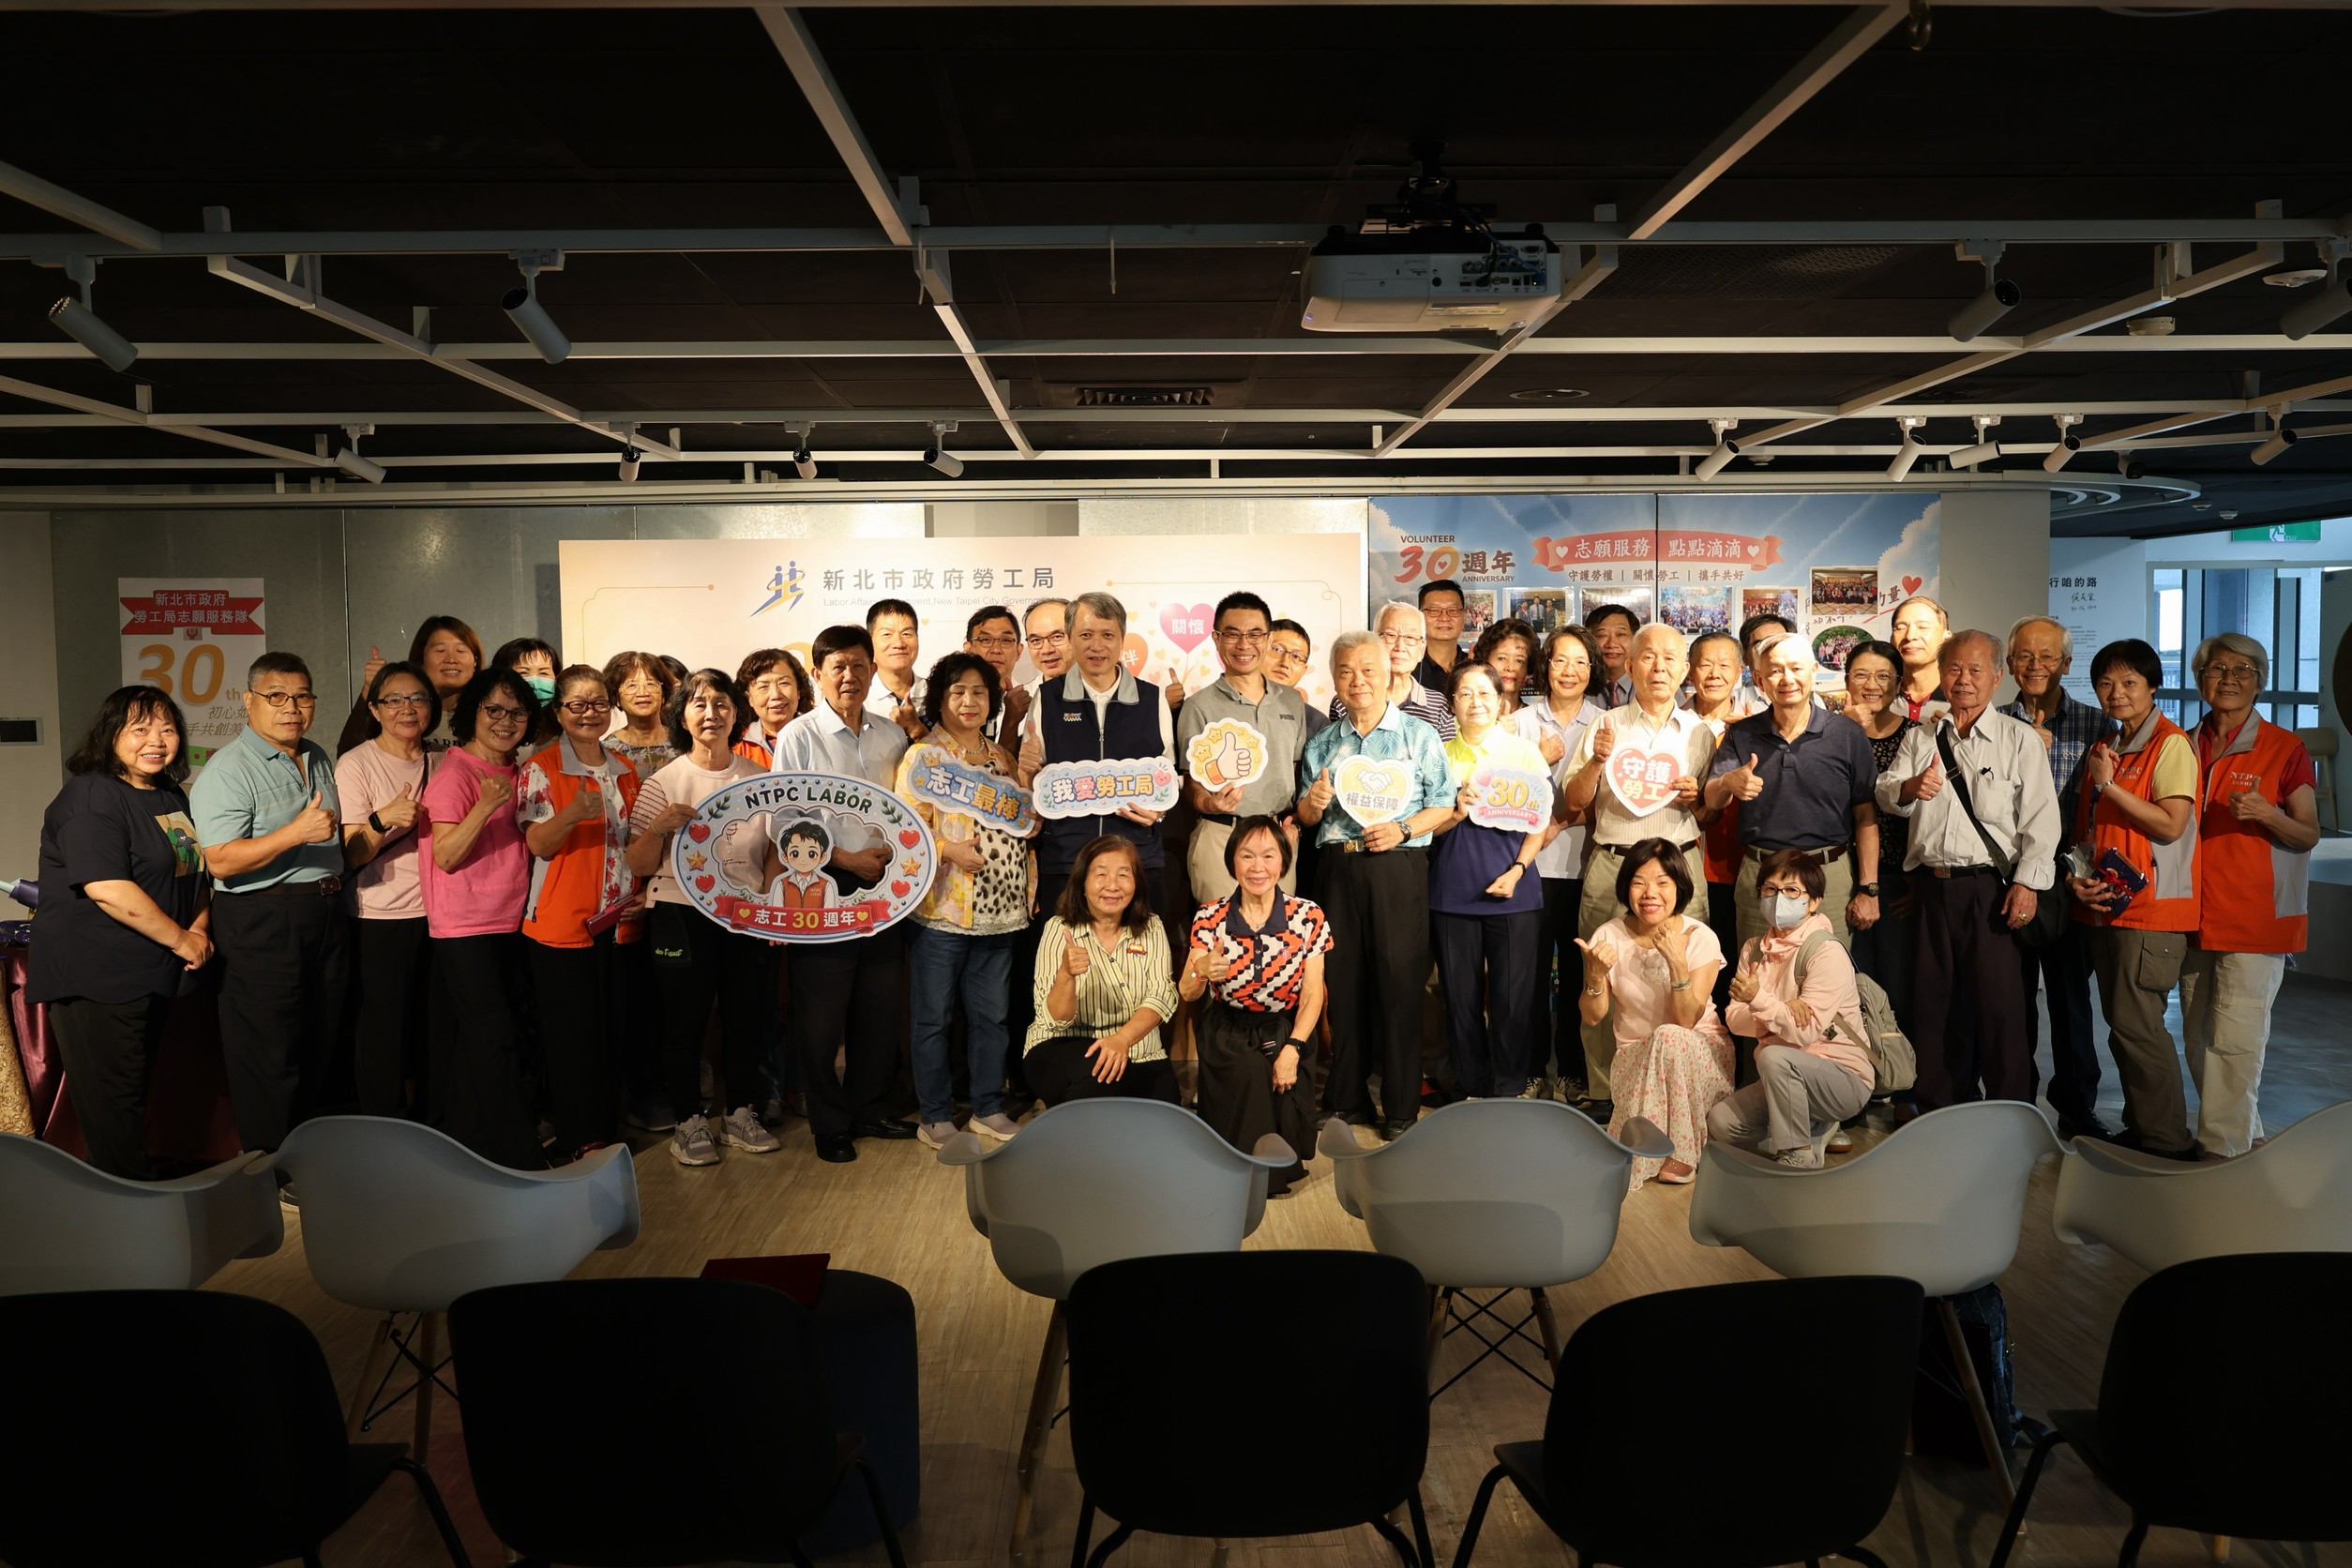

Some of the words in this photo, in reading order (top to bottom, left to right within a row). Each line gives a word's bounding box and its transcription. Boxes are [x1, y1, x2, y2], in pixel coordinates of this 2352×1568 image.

[1400, 535, 1455, 543] VOLUNTEER
[1575, 538, 1651, 558] 志願服務
[1667, 539, 1741, 558] 點點滴滴
[822, 567, 1054, 592] 新北市政府勞工局
[1568, 569, 1614, 582] 守護勞權
[1633, 569, 1681, 581] 關懷勞工
[1698, 569, 1745, 581] 攜手共好
[2049, 577, 2097, 588] 行咱的路
[155, 593, 226, 607] 新北市政府
[823, 598, 848, 607] Labor
[955, 596, 980, 607] Taipei
[983, 596, 999, 607] City
[134, 611, 249, 624] 勞工局志願服務隊
[1171, 619, 1205, 635] 關懷
[1622, 757, 1672, 784] 守護
[927, 766, 1021, 822] 志工最棒
[1051, 774, 1153, 804] 我愛勞工局
[1487, 777, 1540, 810] 30th
[1622, 777, 1666, 801] 勞工
[745, 786, 800, 809] NTPC
[807, 786, 873, 814] LABOR
[1346, 792, 1399, 811] 權益保障
[1486, 807, 1532, 820] ANNIVERSARY
